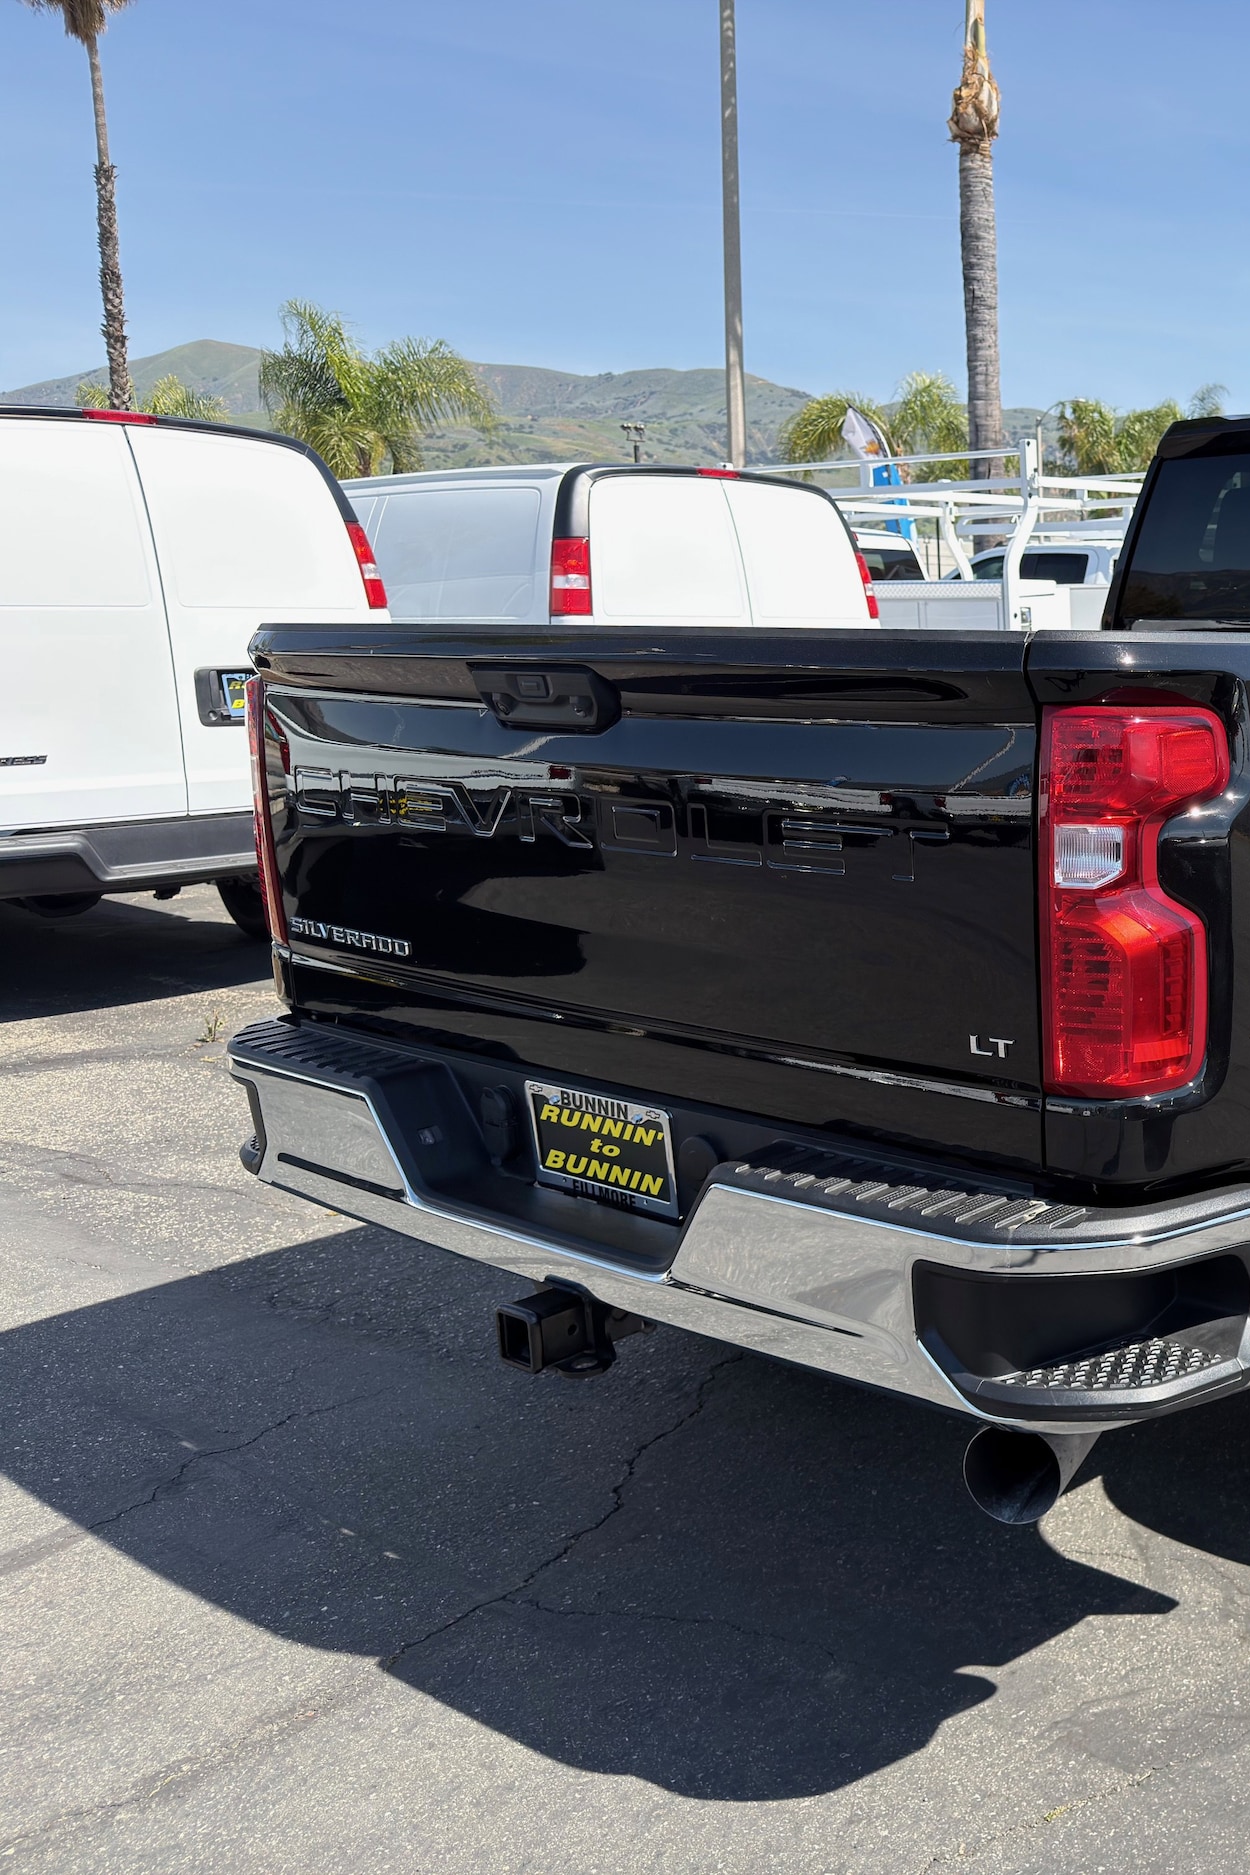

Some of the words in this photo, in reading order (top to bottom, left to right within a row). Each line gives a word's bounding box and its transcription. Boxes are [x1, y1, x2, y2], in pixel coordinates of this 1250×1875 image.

[296, 765, 950, 882] CHEVROLET
[290, 916, 412, 957] SILVERADO
[969, 1034, 1015, 1058] LT
[560, 1090, 628, 1120] BUNNIN
[540, 1104, 664, 1146] RUNNIN'
[589, 1138, 621, 1157] to
[545, 1149, 664, 1196] BUNNIN
[572, 1179, 636, 1209] FILLMORE
